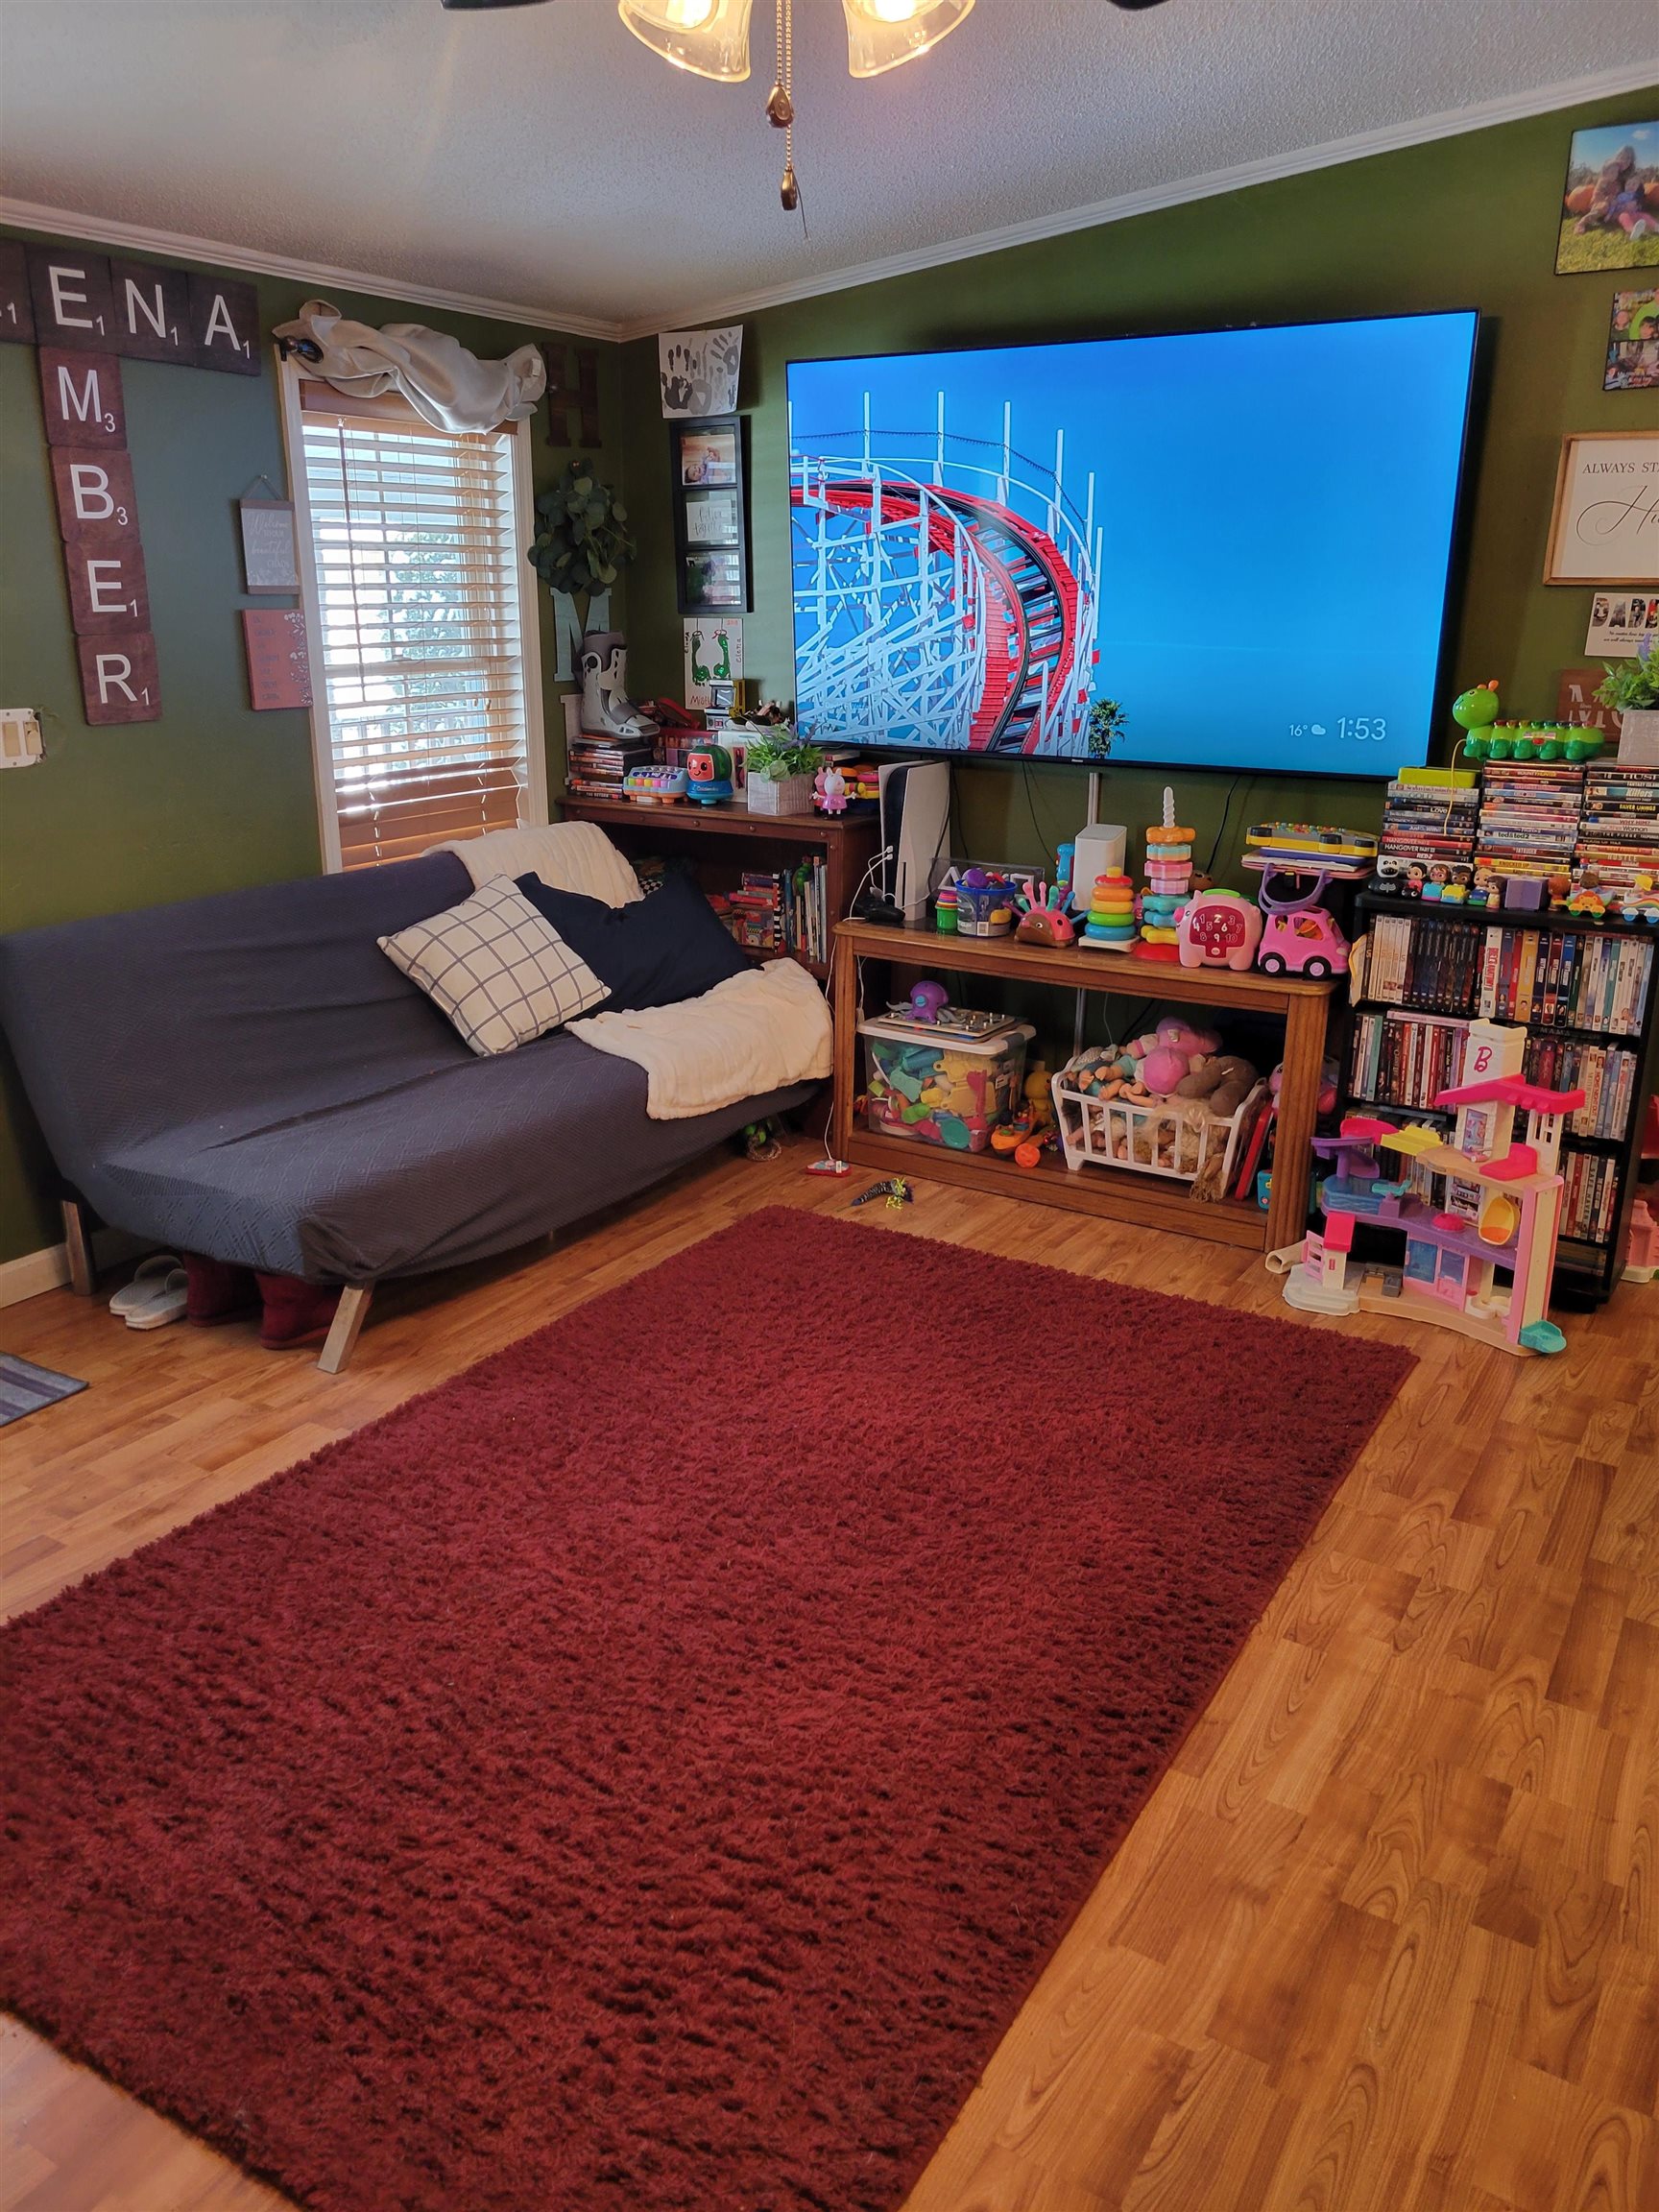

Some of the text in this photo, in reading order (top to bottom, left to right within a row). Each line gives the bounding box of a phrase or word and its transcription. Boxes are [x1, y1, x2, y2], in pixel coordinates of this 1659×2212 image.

[1582, 462, 1635, 474] ALWAYS
[1336, 716, 1386, 741] 1:53
[1384, 844, 1419, 853] HANGOVER
[1214, 914, 1222, 924] 2
[1221, 923, 1228, 932] 6
[1214, 933, 1220, 943] 9
[1474, 1046, 1493, 1073] B
[1583, 1167, 1596, 1220] SAFE HAVEN
